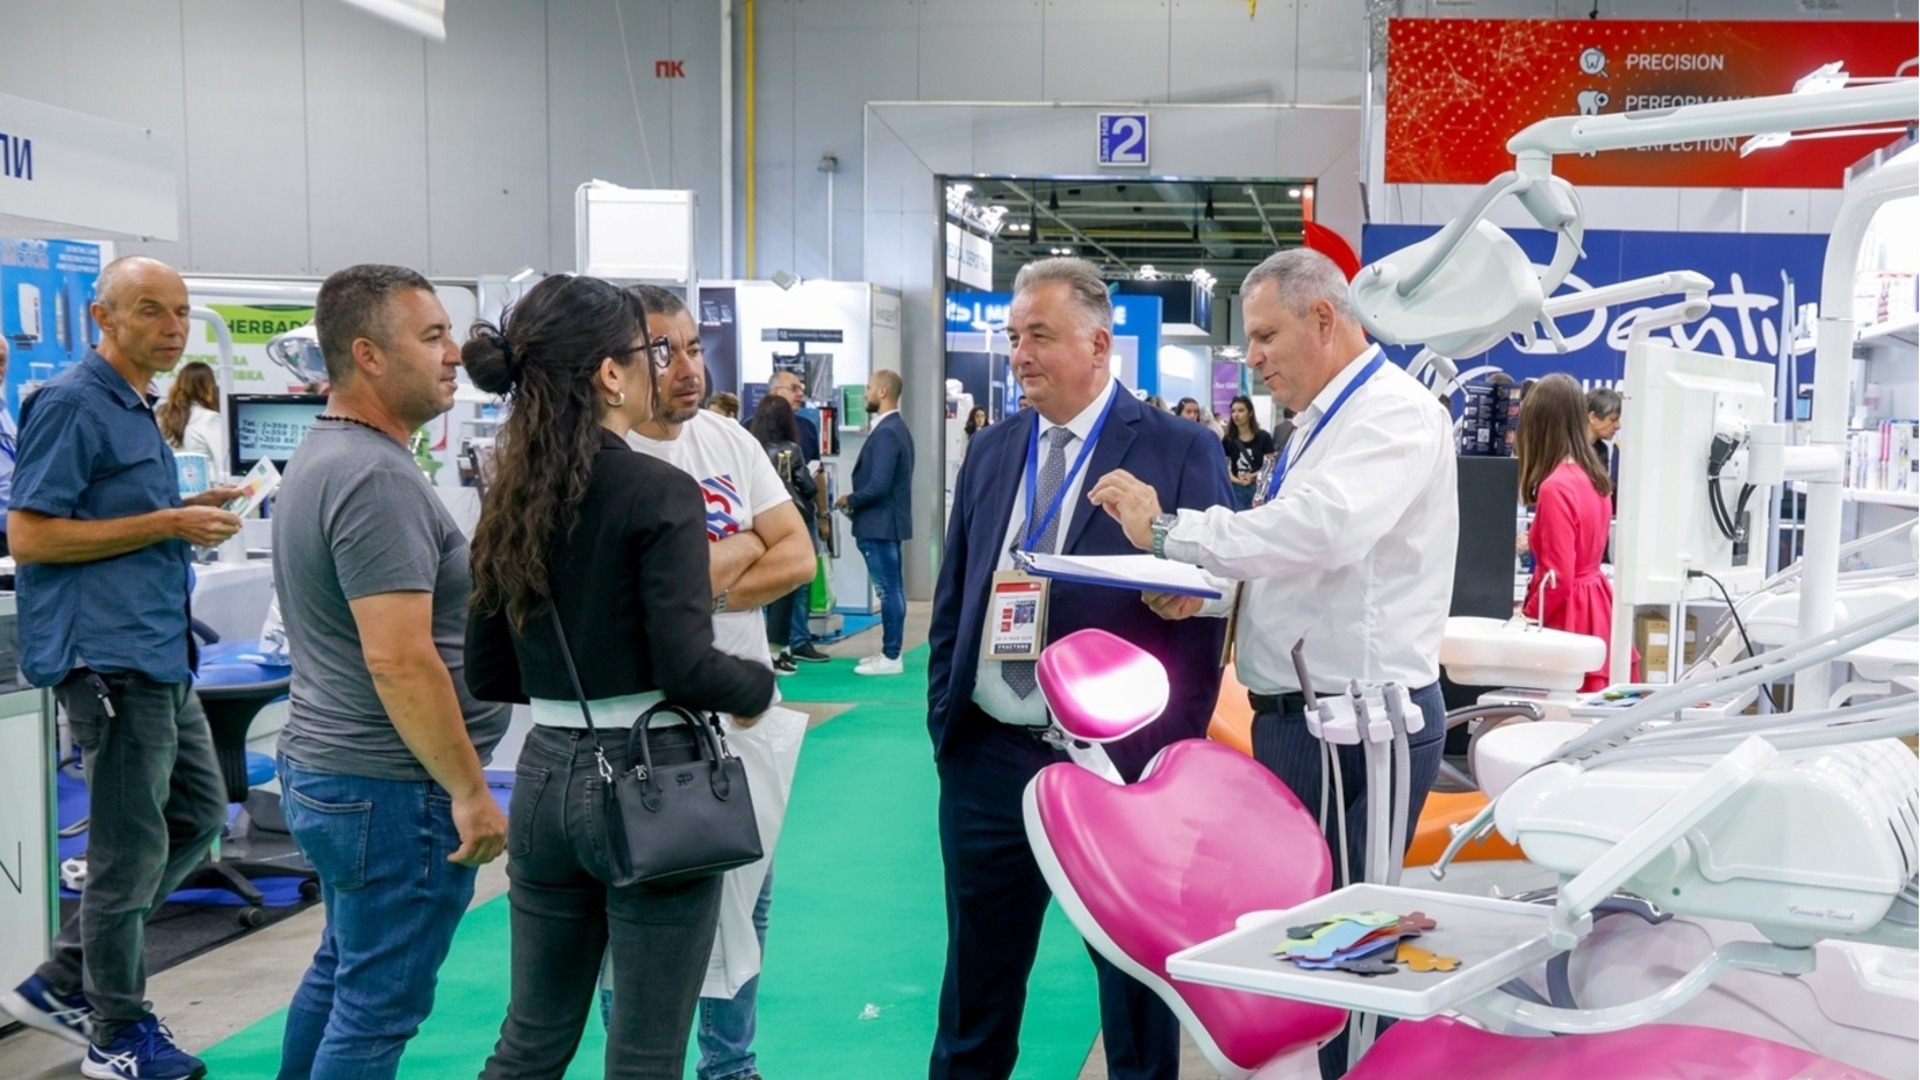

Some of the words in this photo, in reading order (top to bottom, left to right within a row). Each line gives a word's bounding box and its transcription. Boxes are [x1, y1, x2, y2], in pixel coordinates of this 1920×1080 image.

[655, 60, 686, 78] ПК
[1626, 53, 1725, 71] PRECISION
[1625, 94, 1752, 112] PERFORM
[1111, 117, 1143, 162] 2
[1624, 136, 1737, 152] ECTION
[226, 319, 314, 334] HERBAD
